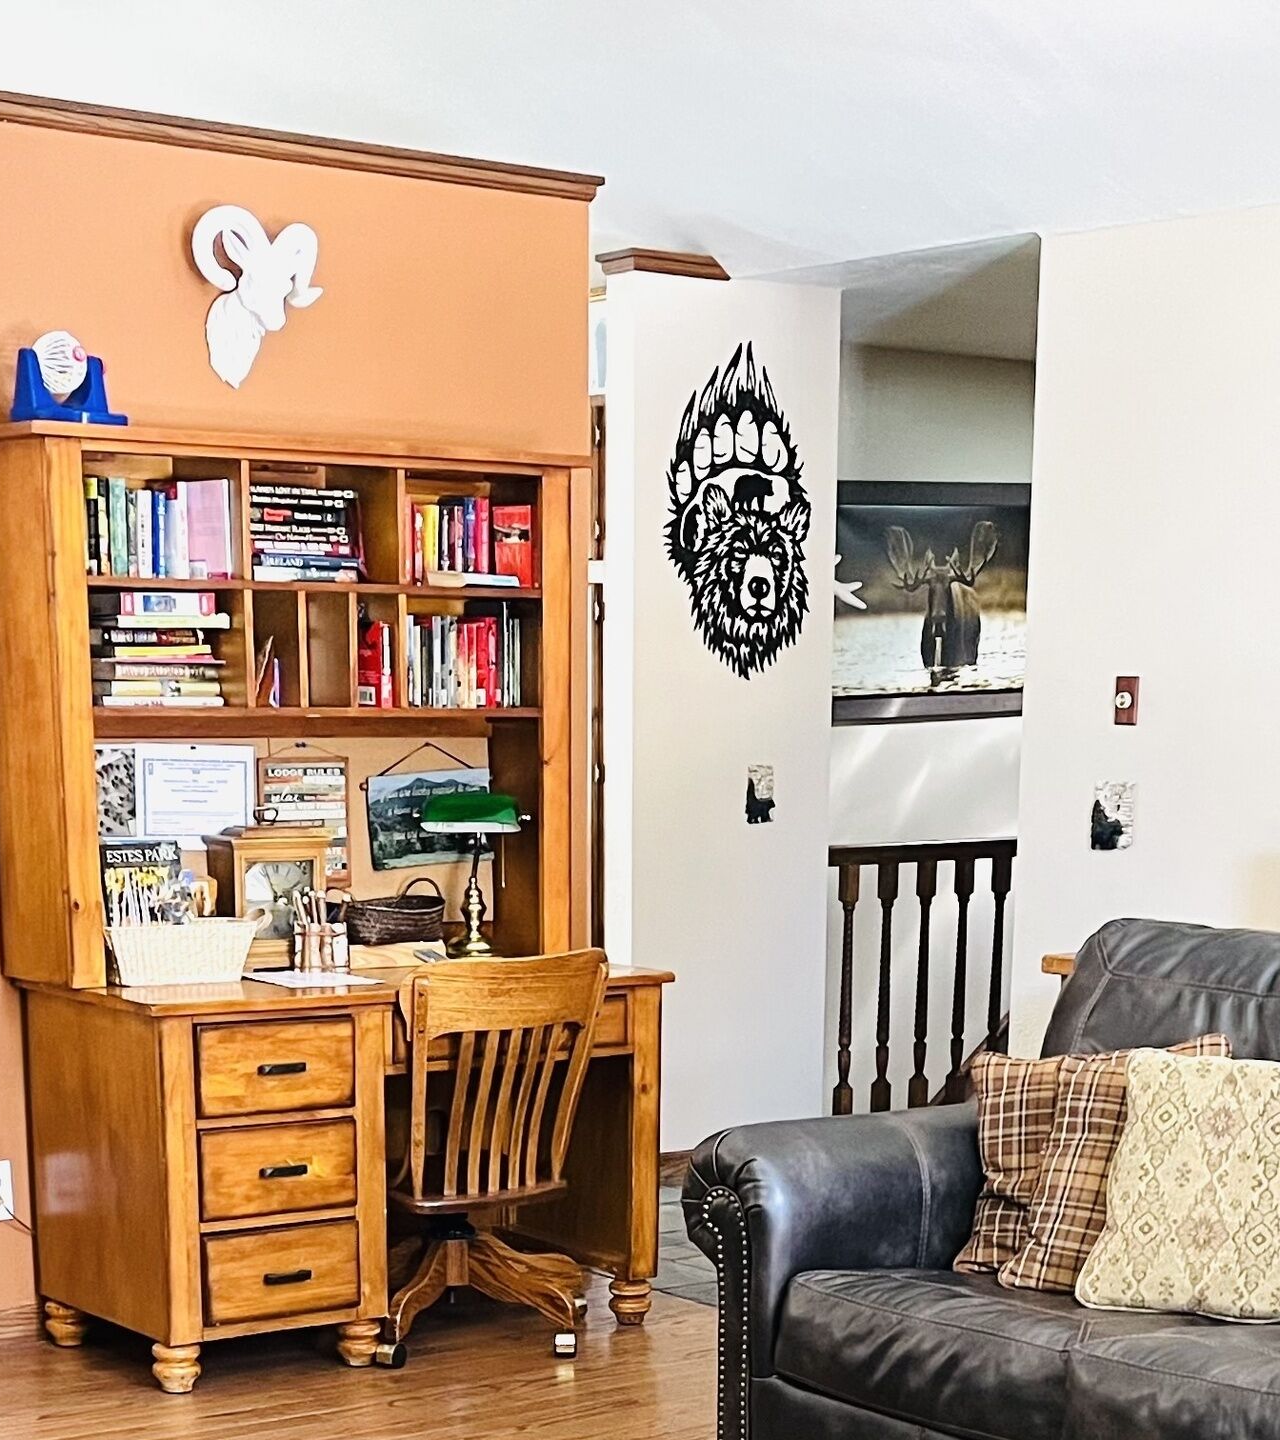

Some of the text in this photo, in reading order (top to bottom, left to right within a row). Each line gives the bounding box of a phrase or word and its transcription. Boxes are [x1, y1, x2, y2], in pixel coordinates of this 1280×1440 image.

[267, 768, 303, 778] LODGE
[106, 842, 179, 863] ESTES PARK
